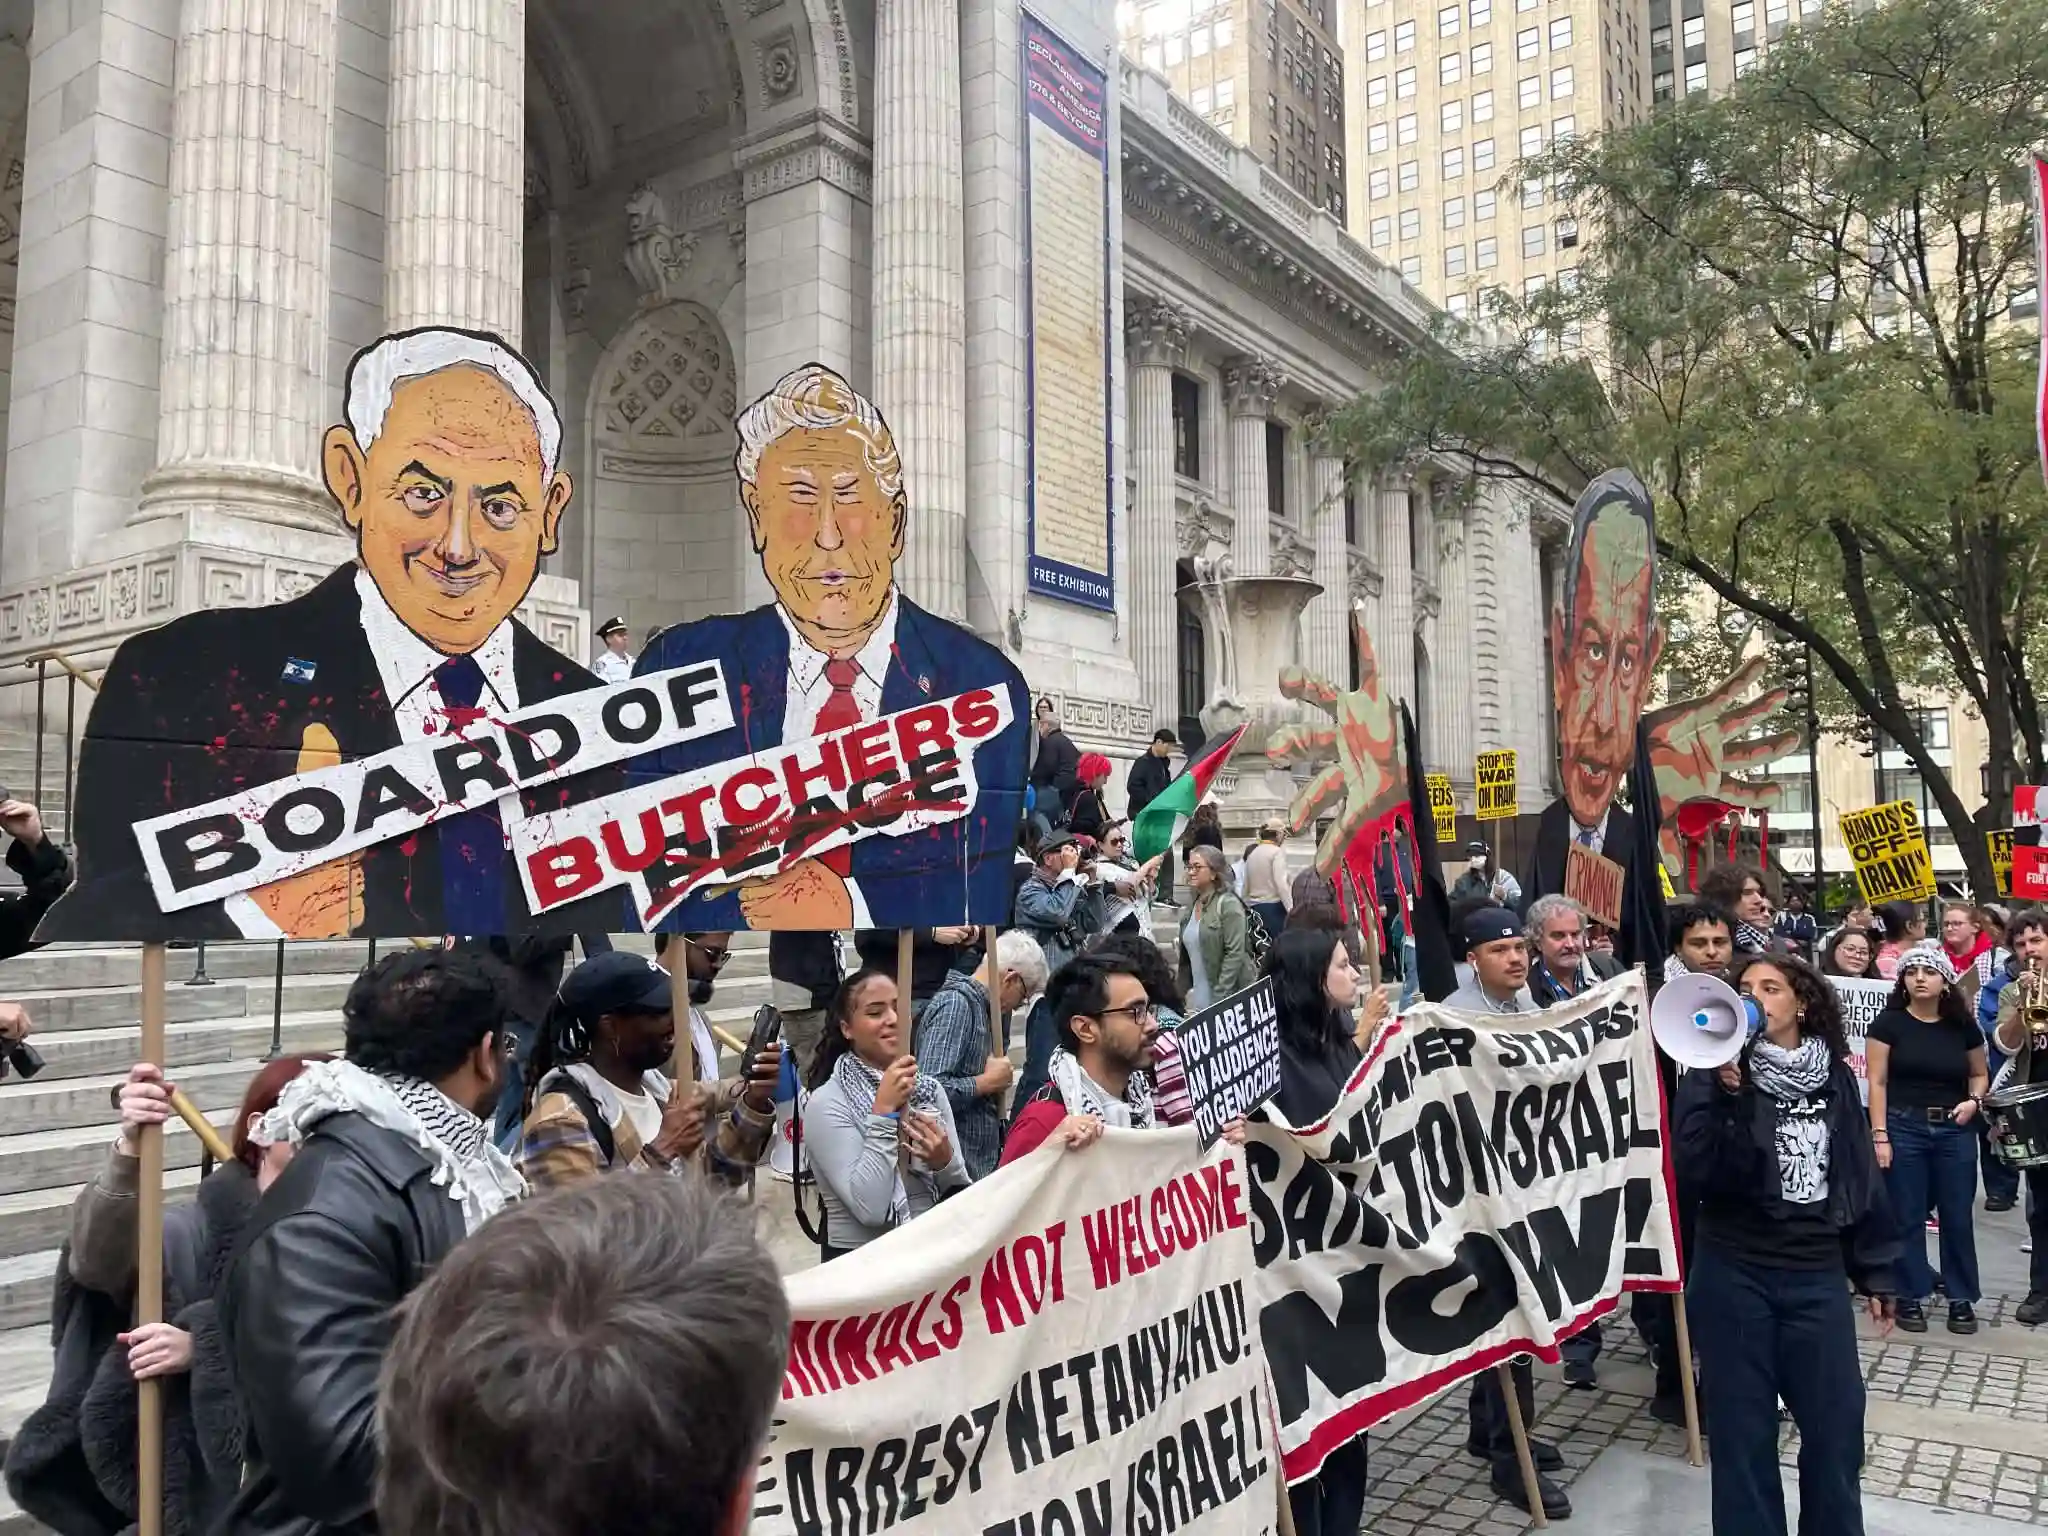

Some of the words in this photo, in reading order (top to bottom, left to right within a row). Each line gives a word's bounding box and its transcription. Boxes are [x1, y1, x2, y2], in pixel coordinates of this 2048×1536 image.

[1028, 39, 1084, 93] DECLARING
[1028, 79, 1048, 99] 1776
[1057, 101, 1097, 138] BEYOND
[1059, 84, 1101, 122] AMERICA
[1034, 567, 1056, 585] FREE
[1058, 574, 1109, 600] EXHIBITION
[155, 714, 582, 892] BOARD
[600, 667, 718, 744] OF
[1478, 754, 1500, 769] STOP
[1501, 752, 1514, 768] THE
[1478, 768, 1514, 784] WAR
[527, 689, 999, 909] BUTCHERS
[1478, 786, 1491, 808] ON
[1493, 784, 1516, 808] IRAN!
[1843, 807, 1901, 846] HANDS
[1853, 833, 1907, 862] OFF
[1567, 850, 1619, 922] CRIMINAL
[1859, 854, 1922, 898] IRAN!
[2026, 872, 2044, 885] FOR
[1179, 1021, 1211, 1067] YOU
[1215, 1002, 1248, 1048] ARE
[1250, 988, 1277, 1027] ALL
[1859, 990, 1887, 1008] YOR
[1188, 1067, 1209, 1105] AN
[1209, 1019, 1279, 1091] AUDIENCE
[1500, 1000, 1639, 1068] STATES:
[1195, 1102, 1215, 1141] TO
[1213, 1053, 1281, 1123] GENOCIDE
[781, 1276, 972, 1400] MINALS
[980, 1220, 1066, 1334] NOT
[1081, 1157, 1248, 1291] WELCOME
[1259, 1176, 1663, 1429] NOW!
[785, 1398, 1000, 1536] ARREST
[1005, 1278, 1251, 1474] NETANYAHU!
[1125, 1386, 1267, 1532] ISRAEL!
